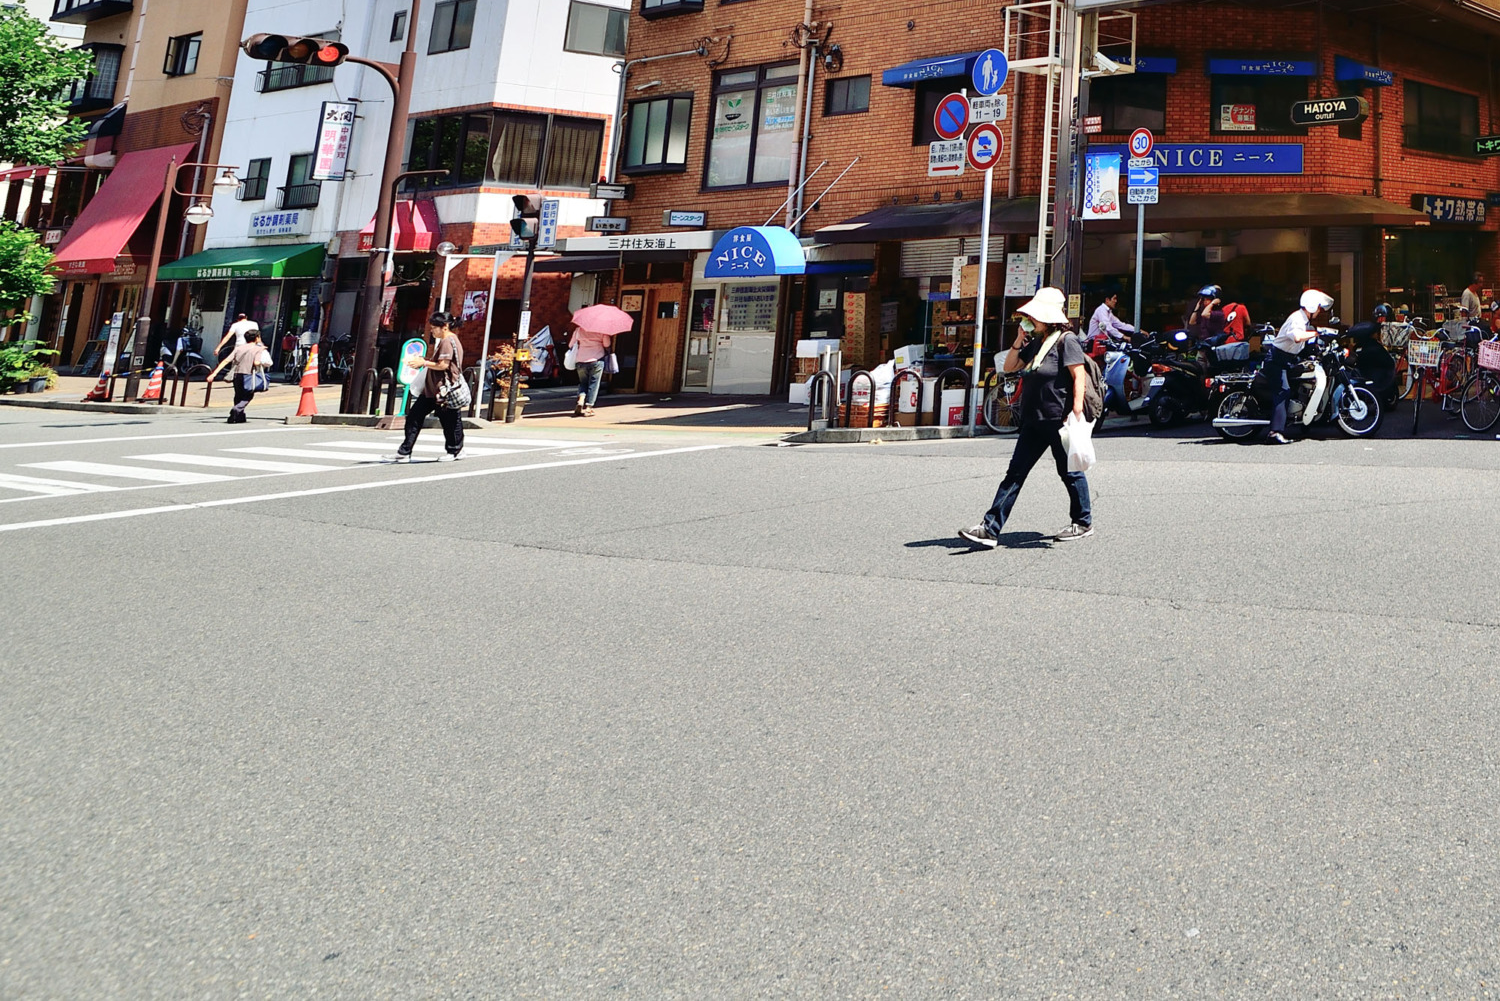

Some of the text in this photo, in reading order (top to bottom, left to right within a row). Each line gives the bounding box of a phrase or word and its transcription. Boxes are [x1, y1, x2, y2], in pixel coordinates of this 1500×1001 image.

[919, 64, 944, 77] NICE
[1262, 60, 1295, 72] NICE
[1232, 106, 1255, 114] テナント
[1304, 100, 1347, 115] HATOYA
[336, 127, 349, 159] 中華料理
[1134, 136, 1148, 150] 30
[1153, 149, 1223, 167] NICE
[1233, 152, 1275, 163] ニース
[1422, 196, 1485, 222] トキワ熱帯魚
[253, 212, 299, 228] はるか調剤薬局
[671, 214, 703, 222] ビーンスターク
[595, 222, 621, 230] いたやど
[608, 238, 677, 249] 三井住友海上
[732, 233, 752, 243] 洋食屋
[715, 245, 767, 269] NICE
[731, 262, 749, 270] ニース
[196, 268, 232, 278] はるか調剤薬局
